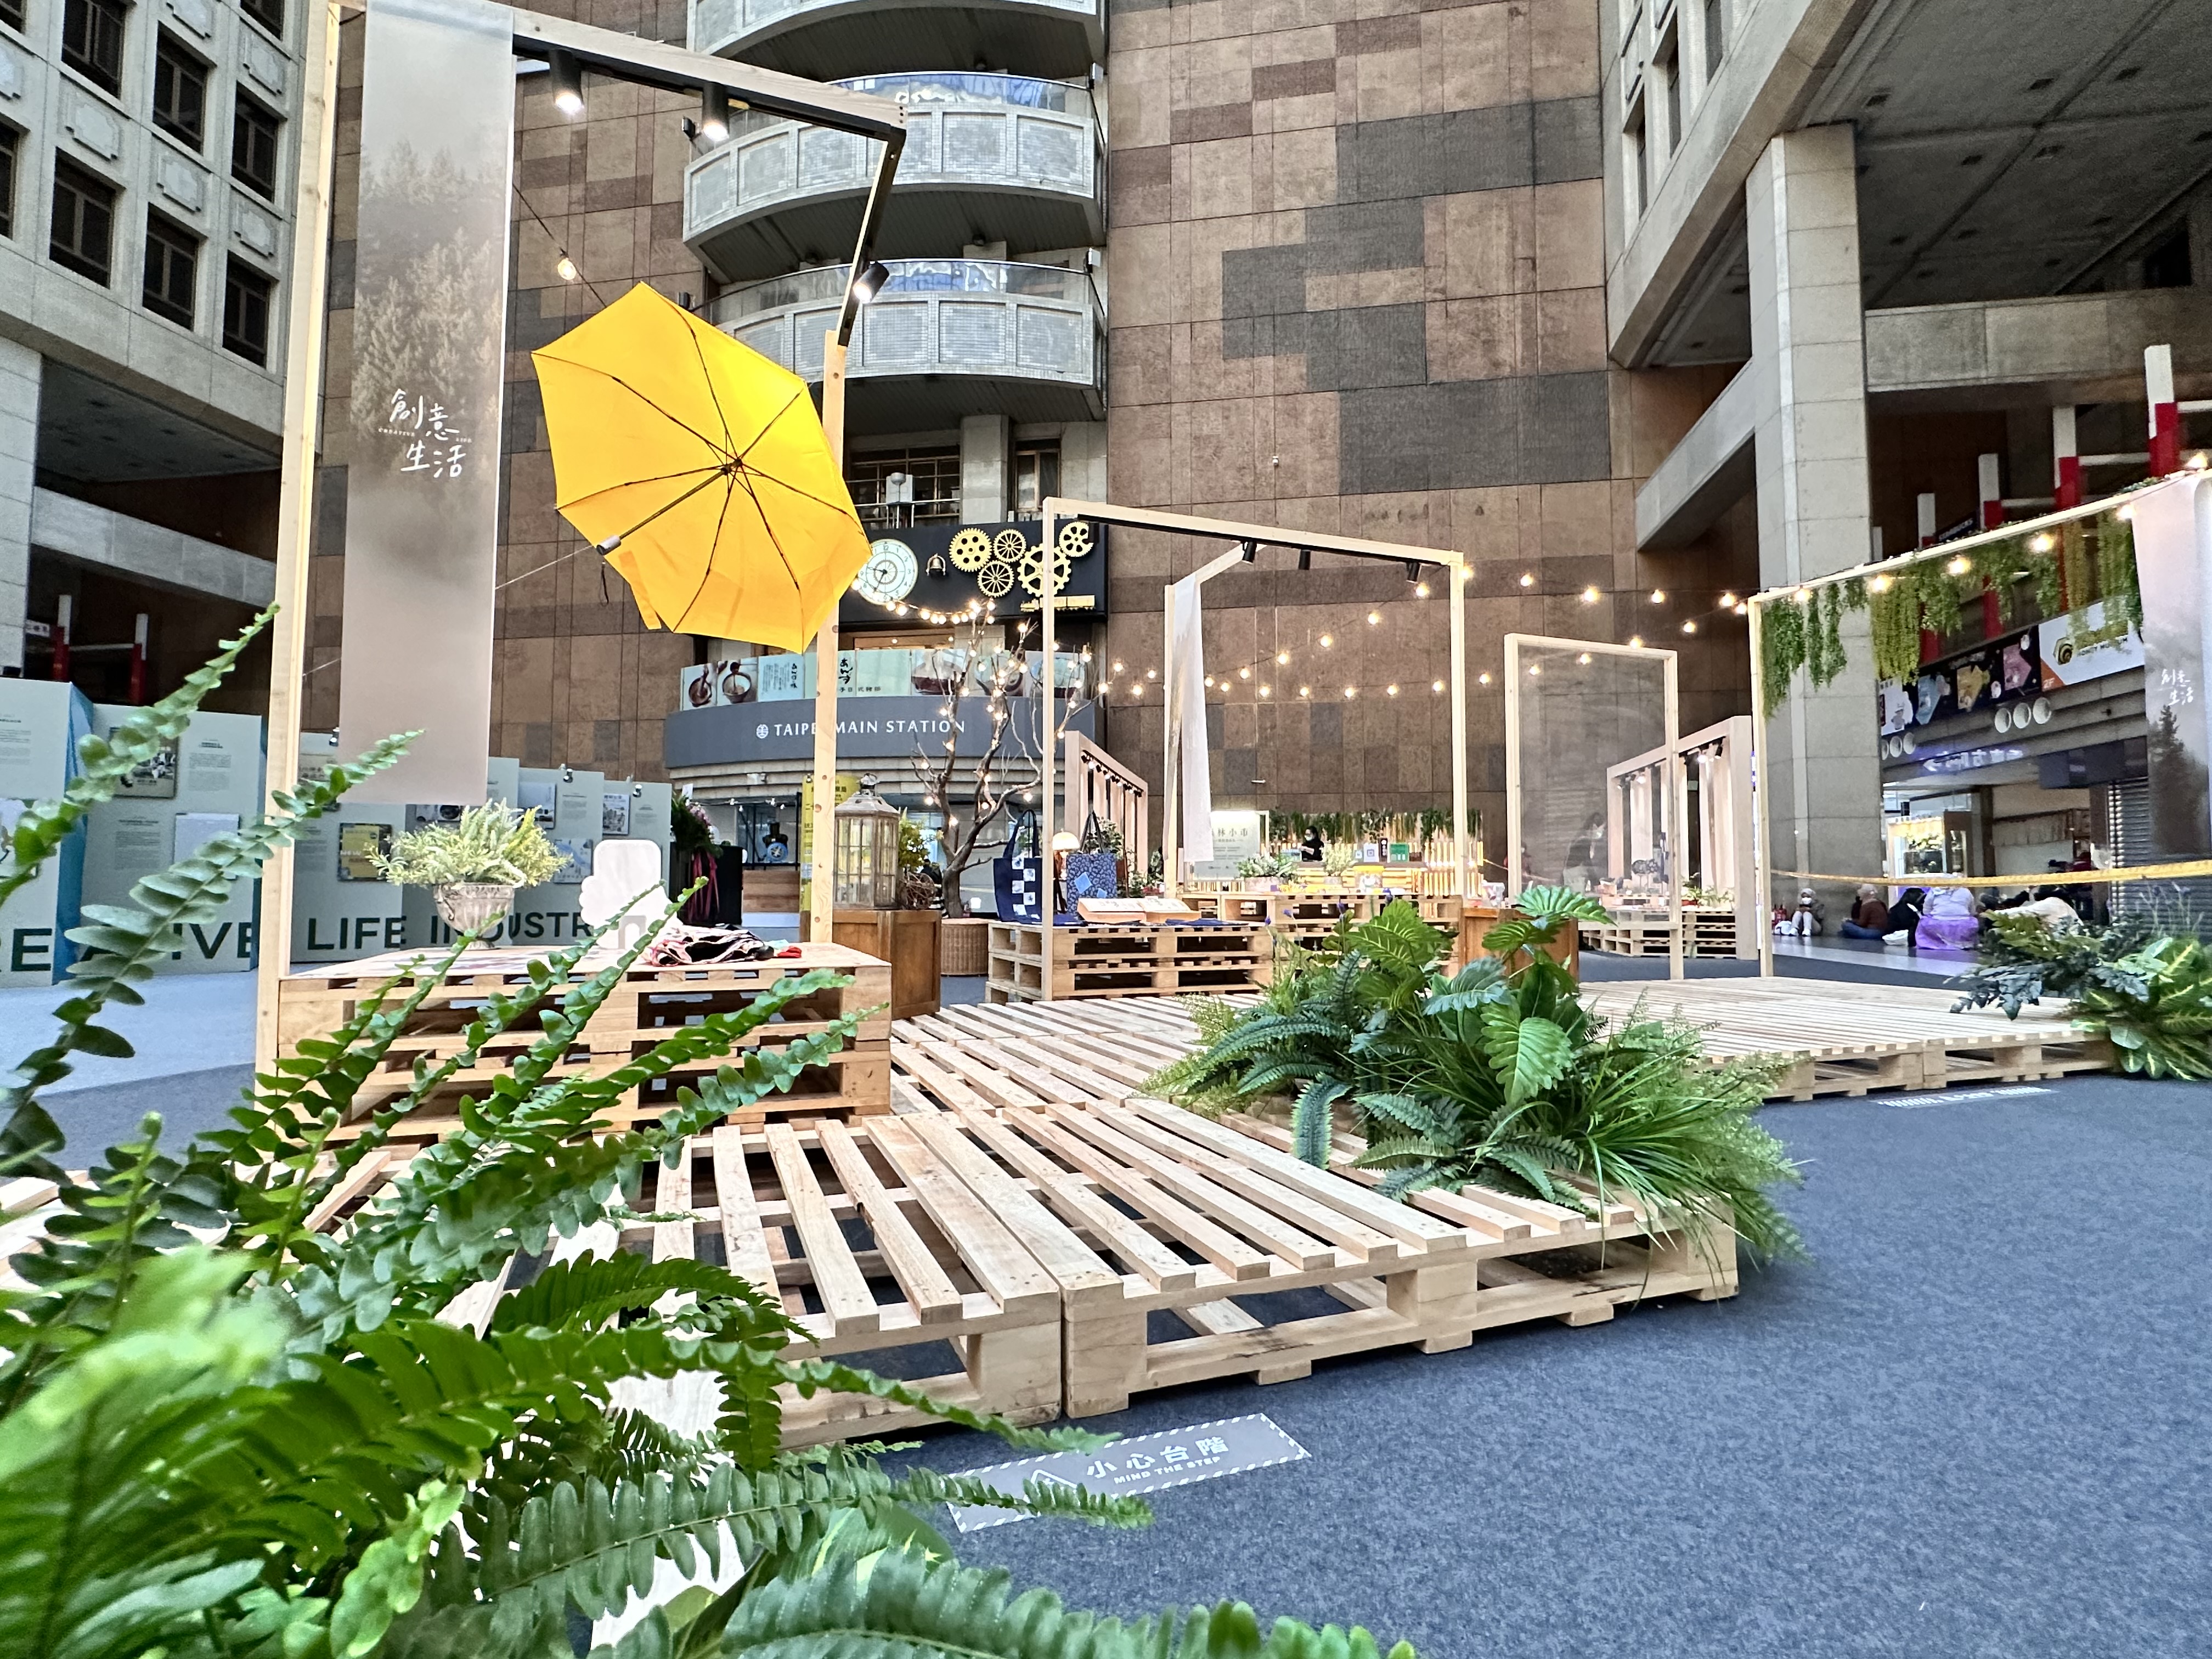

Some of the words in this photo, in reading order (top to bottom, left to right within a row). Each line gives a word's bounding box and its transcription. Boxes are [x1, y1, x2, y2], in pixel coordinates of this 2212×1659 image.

[389, 388, 460, 441] 創意
[400, 439, 466, 478] 生活
[2043, 677, 2056, 689] 2F
[774, 721, 816, 736] TAIPE
[836, 720, 878, 733] MAIN
[885, 719, 966, 733] STATION
[1211, 828, 1248, 837] 林小市
[308, 916, 406, 950] LIFE
[1086, 1436, 1229, 1479] 小心台階
[1114, 1470, 1151, 1484] MIND
[1154, 1464, 1183, 1475] THE
[1187, 1456, 1221, 1469] STEP
